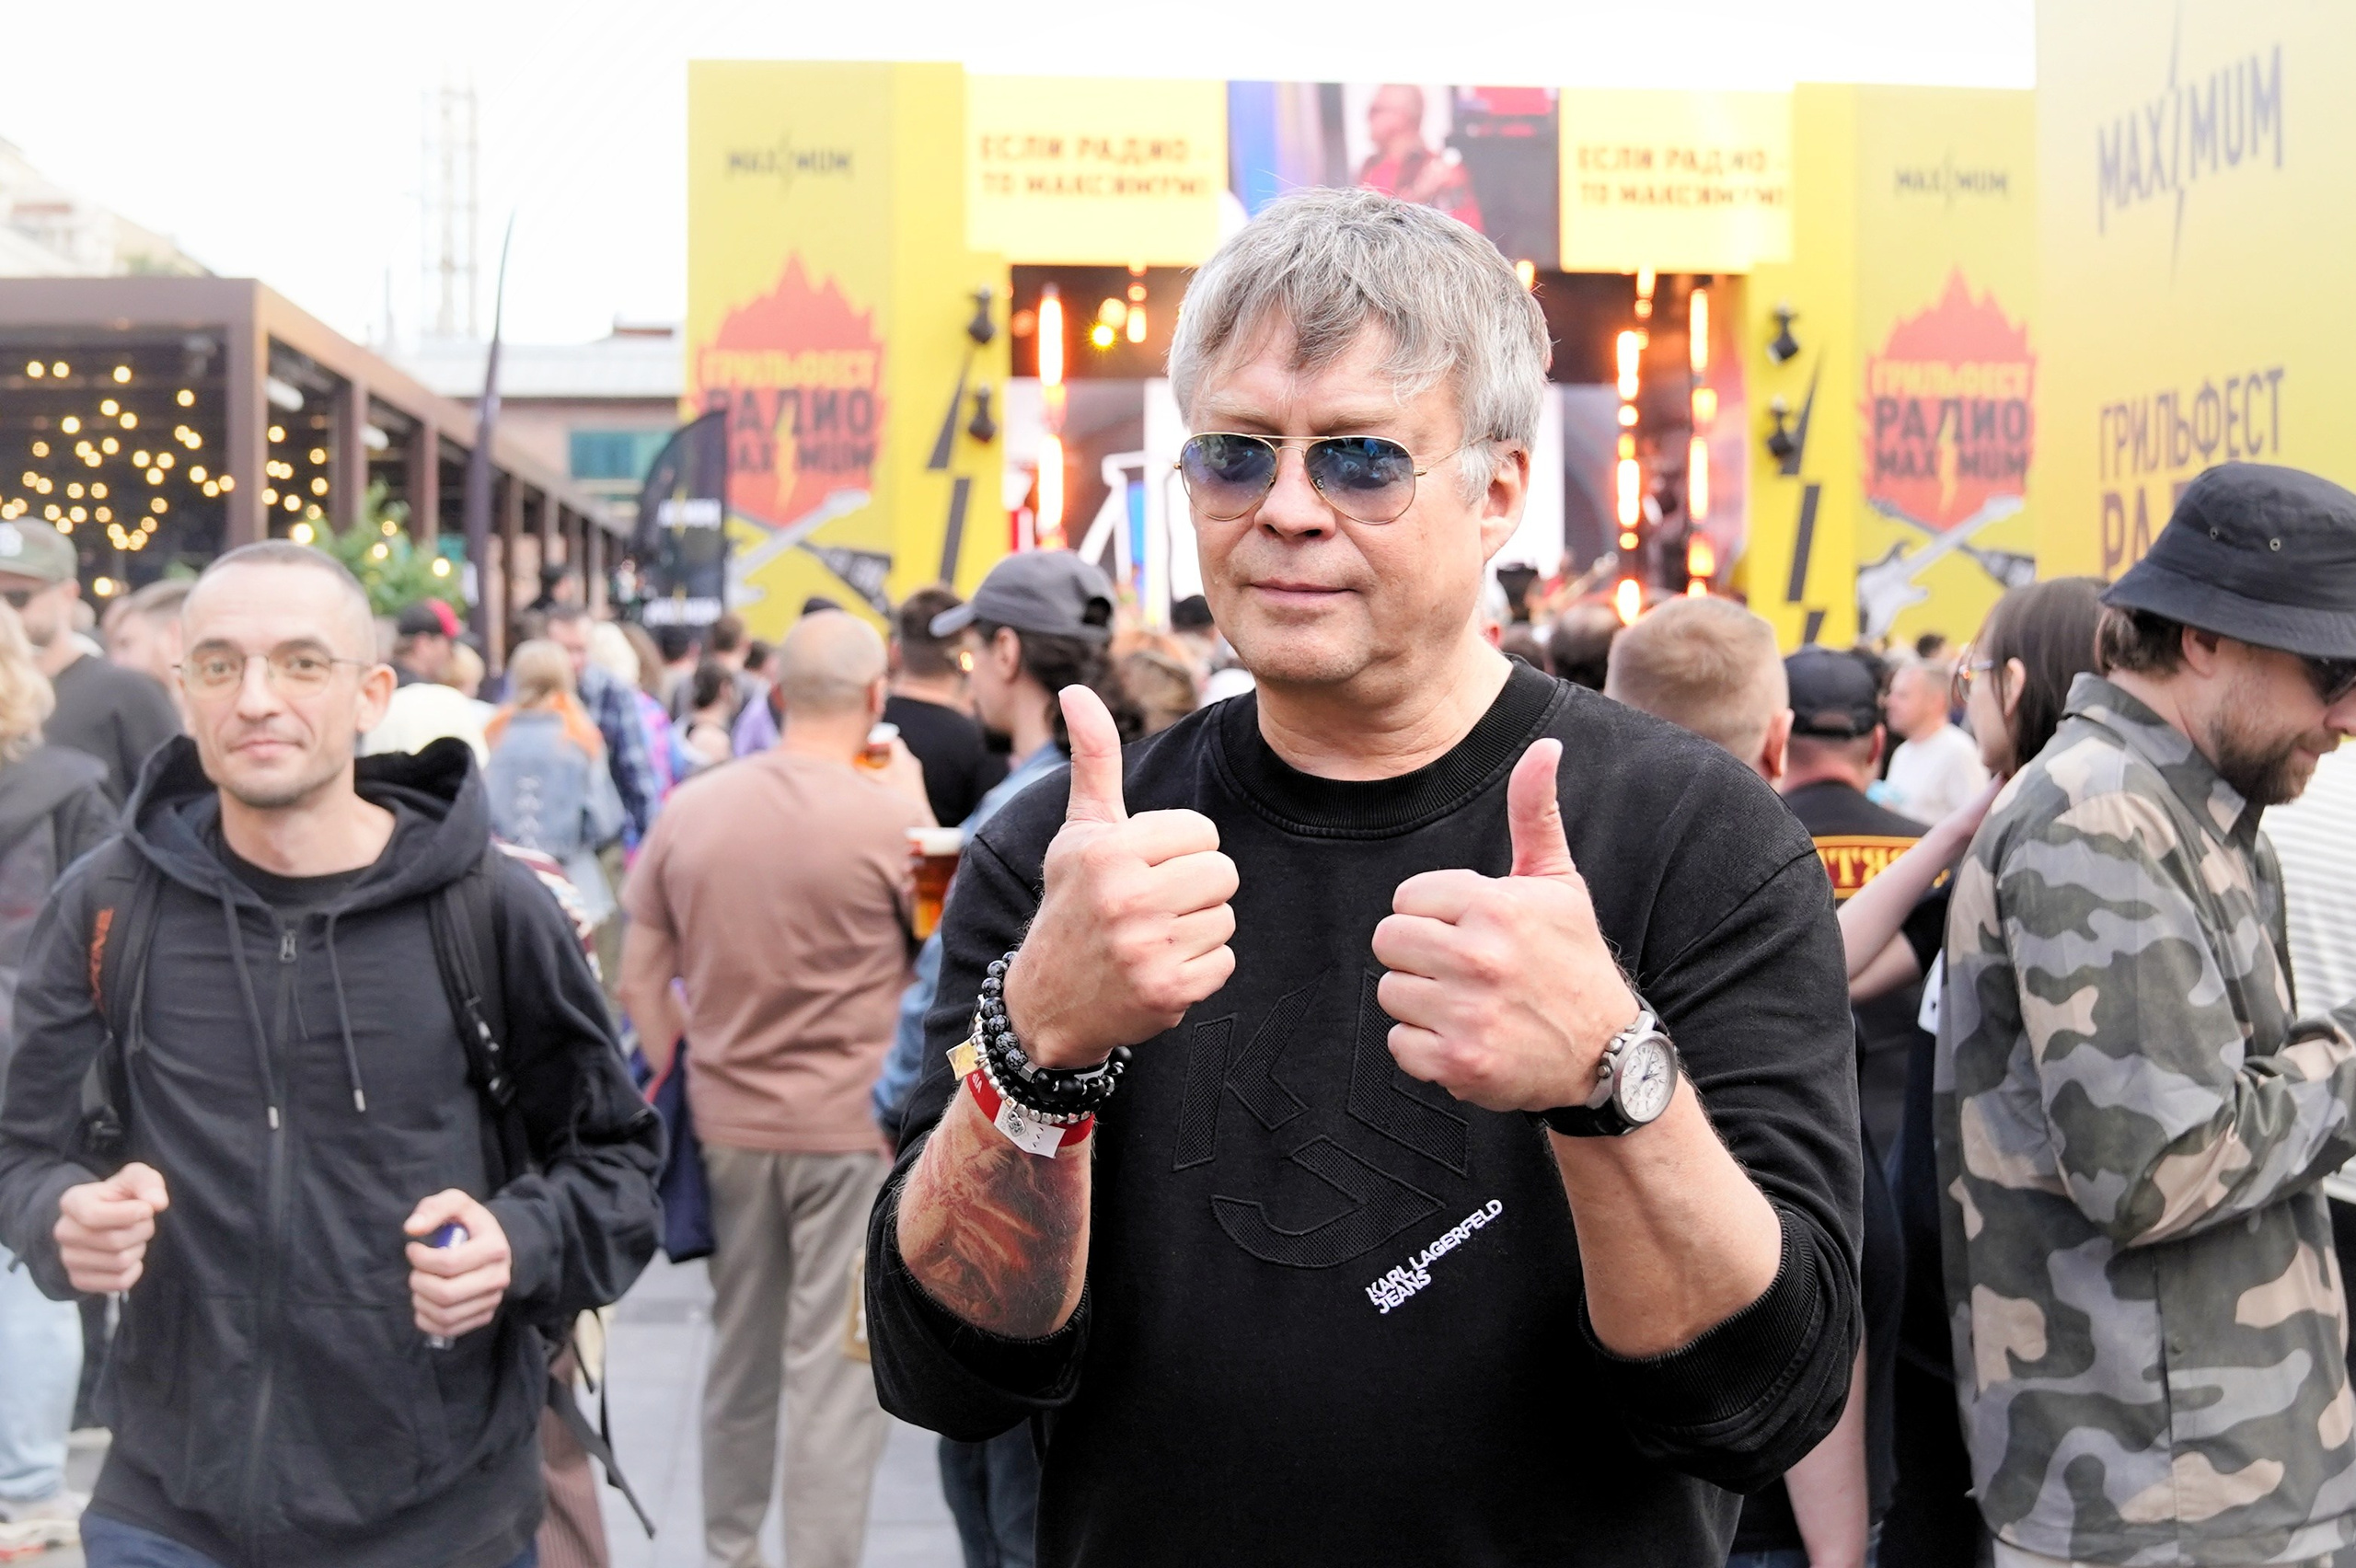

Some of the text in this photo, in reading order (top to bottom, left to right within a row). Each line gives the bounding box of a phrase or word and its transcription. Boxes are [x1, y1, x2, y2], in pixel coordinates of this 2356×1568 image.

[1075, 135, 1190, 165] РАДИО
[1665, 147, 1766, 175] РАДИО
[1875, 397, 2027, 443] РАДИО
[2099, 366, 2283, 482] ГРИЛЬФЕСТ
[1365, 1199, 1503, 1305] KARL LAGERFELD
[1375, 1269, 1432, 1314] JEANS
